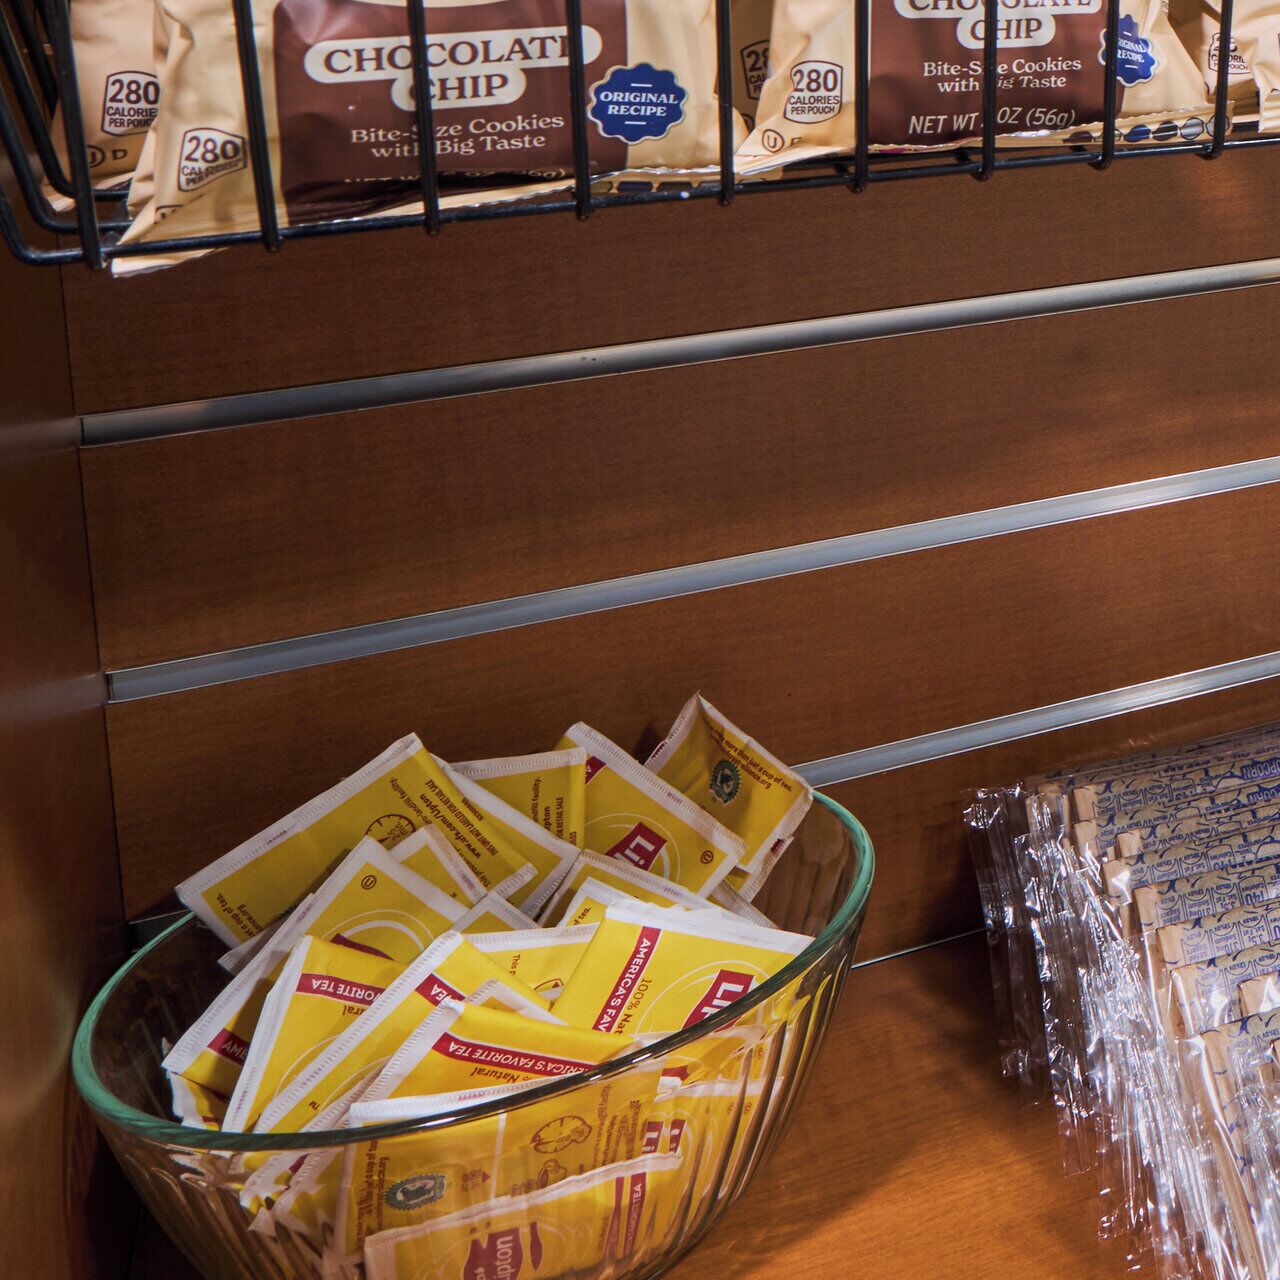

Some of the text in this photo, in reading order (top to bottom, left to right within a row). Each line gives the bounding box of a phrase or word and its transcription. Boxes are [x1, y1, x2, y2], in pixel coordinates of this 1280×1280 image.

[1016, 57, 1082, 73] Cookies
[108, 79, 159, 105] 280
[794, 68, 839, 94] 280
[937, 74, 1067, 93] with Taste
[599, 91, 679, 105] ORIGINAL
[789, 94, 841, 106] CALORIES
[607, 104, 667, 117] RECIPE
[791, 105, 836, 115] PER POUCH
[909, 107, 1076, 135] NET OZ (56g)
[468, 113, 565, 135] Cookies
[185, 136, 240, 164] 280
[436, 133, 546, 157] Big Taste
[311, 977, 334, 993] TEA
[611, 937, 652, 1014] AMERICA'S
[630, 977, 652, 1010] 100%
[449, 1041, 535, 1070] FAVORITE TEA
[470, 1067, 519, 1085] Natural
